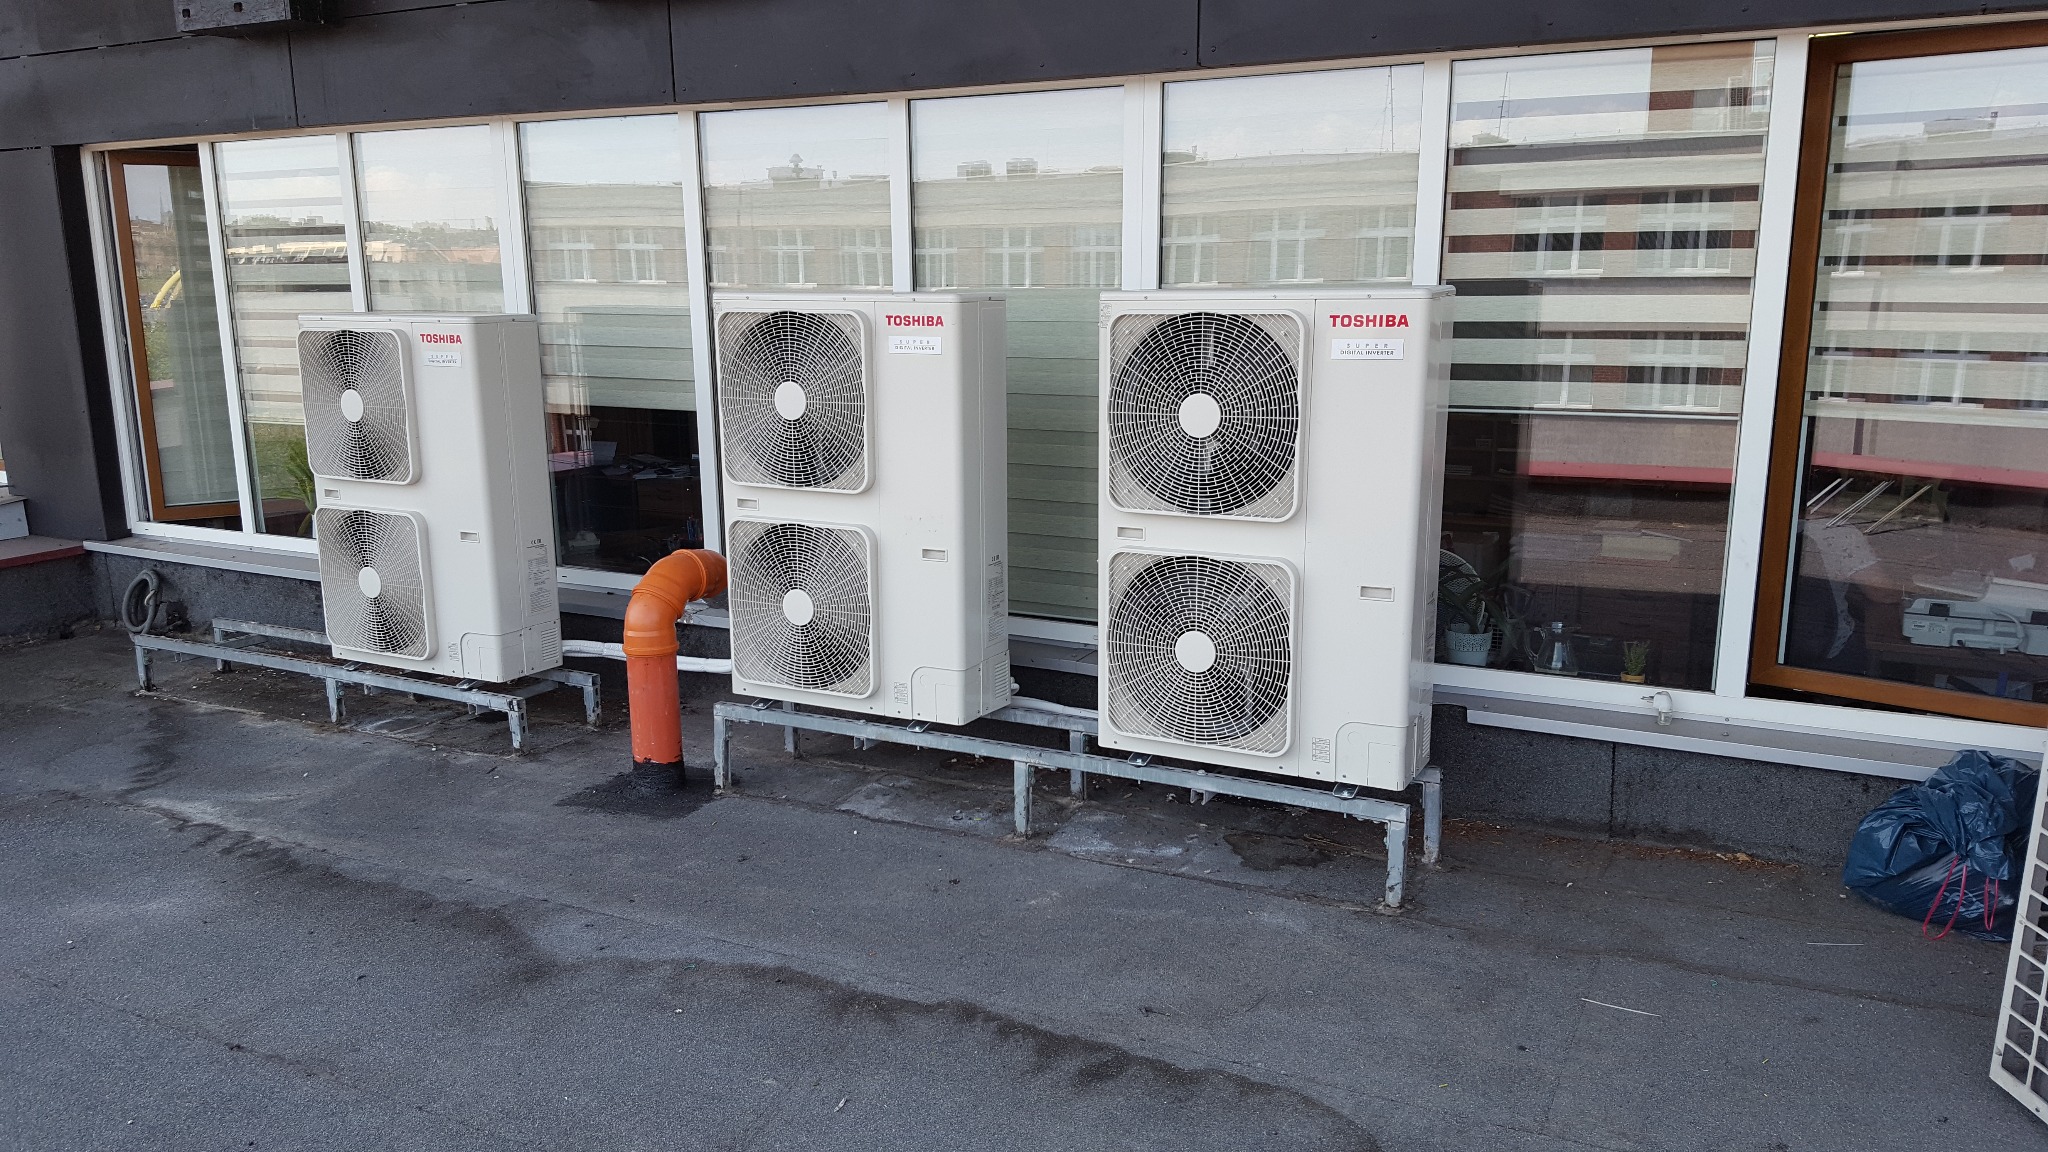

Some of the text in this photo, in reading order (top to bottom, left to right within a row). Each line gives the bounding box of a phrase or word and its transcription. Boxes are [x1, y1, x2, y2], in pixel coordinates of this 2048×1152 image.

[885, 314, 944, 327] TOSHIBA
[1329, 314, 1410, 328] TOSHIBA
[419, 333, 463, 345] TOSHIBA
